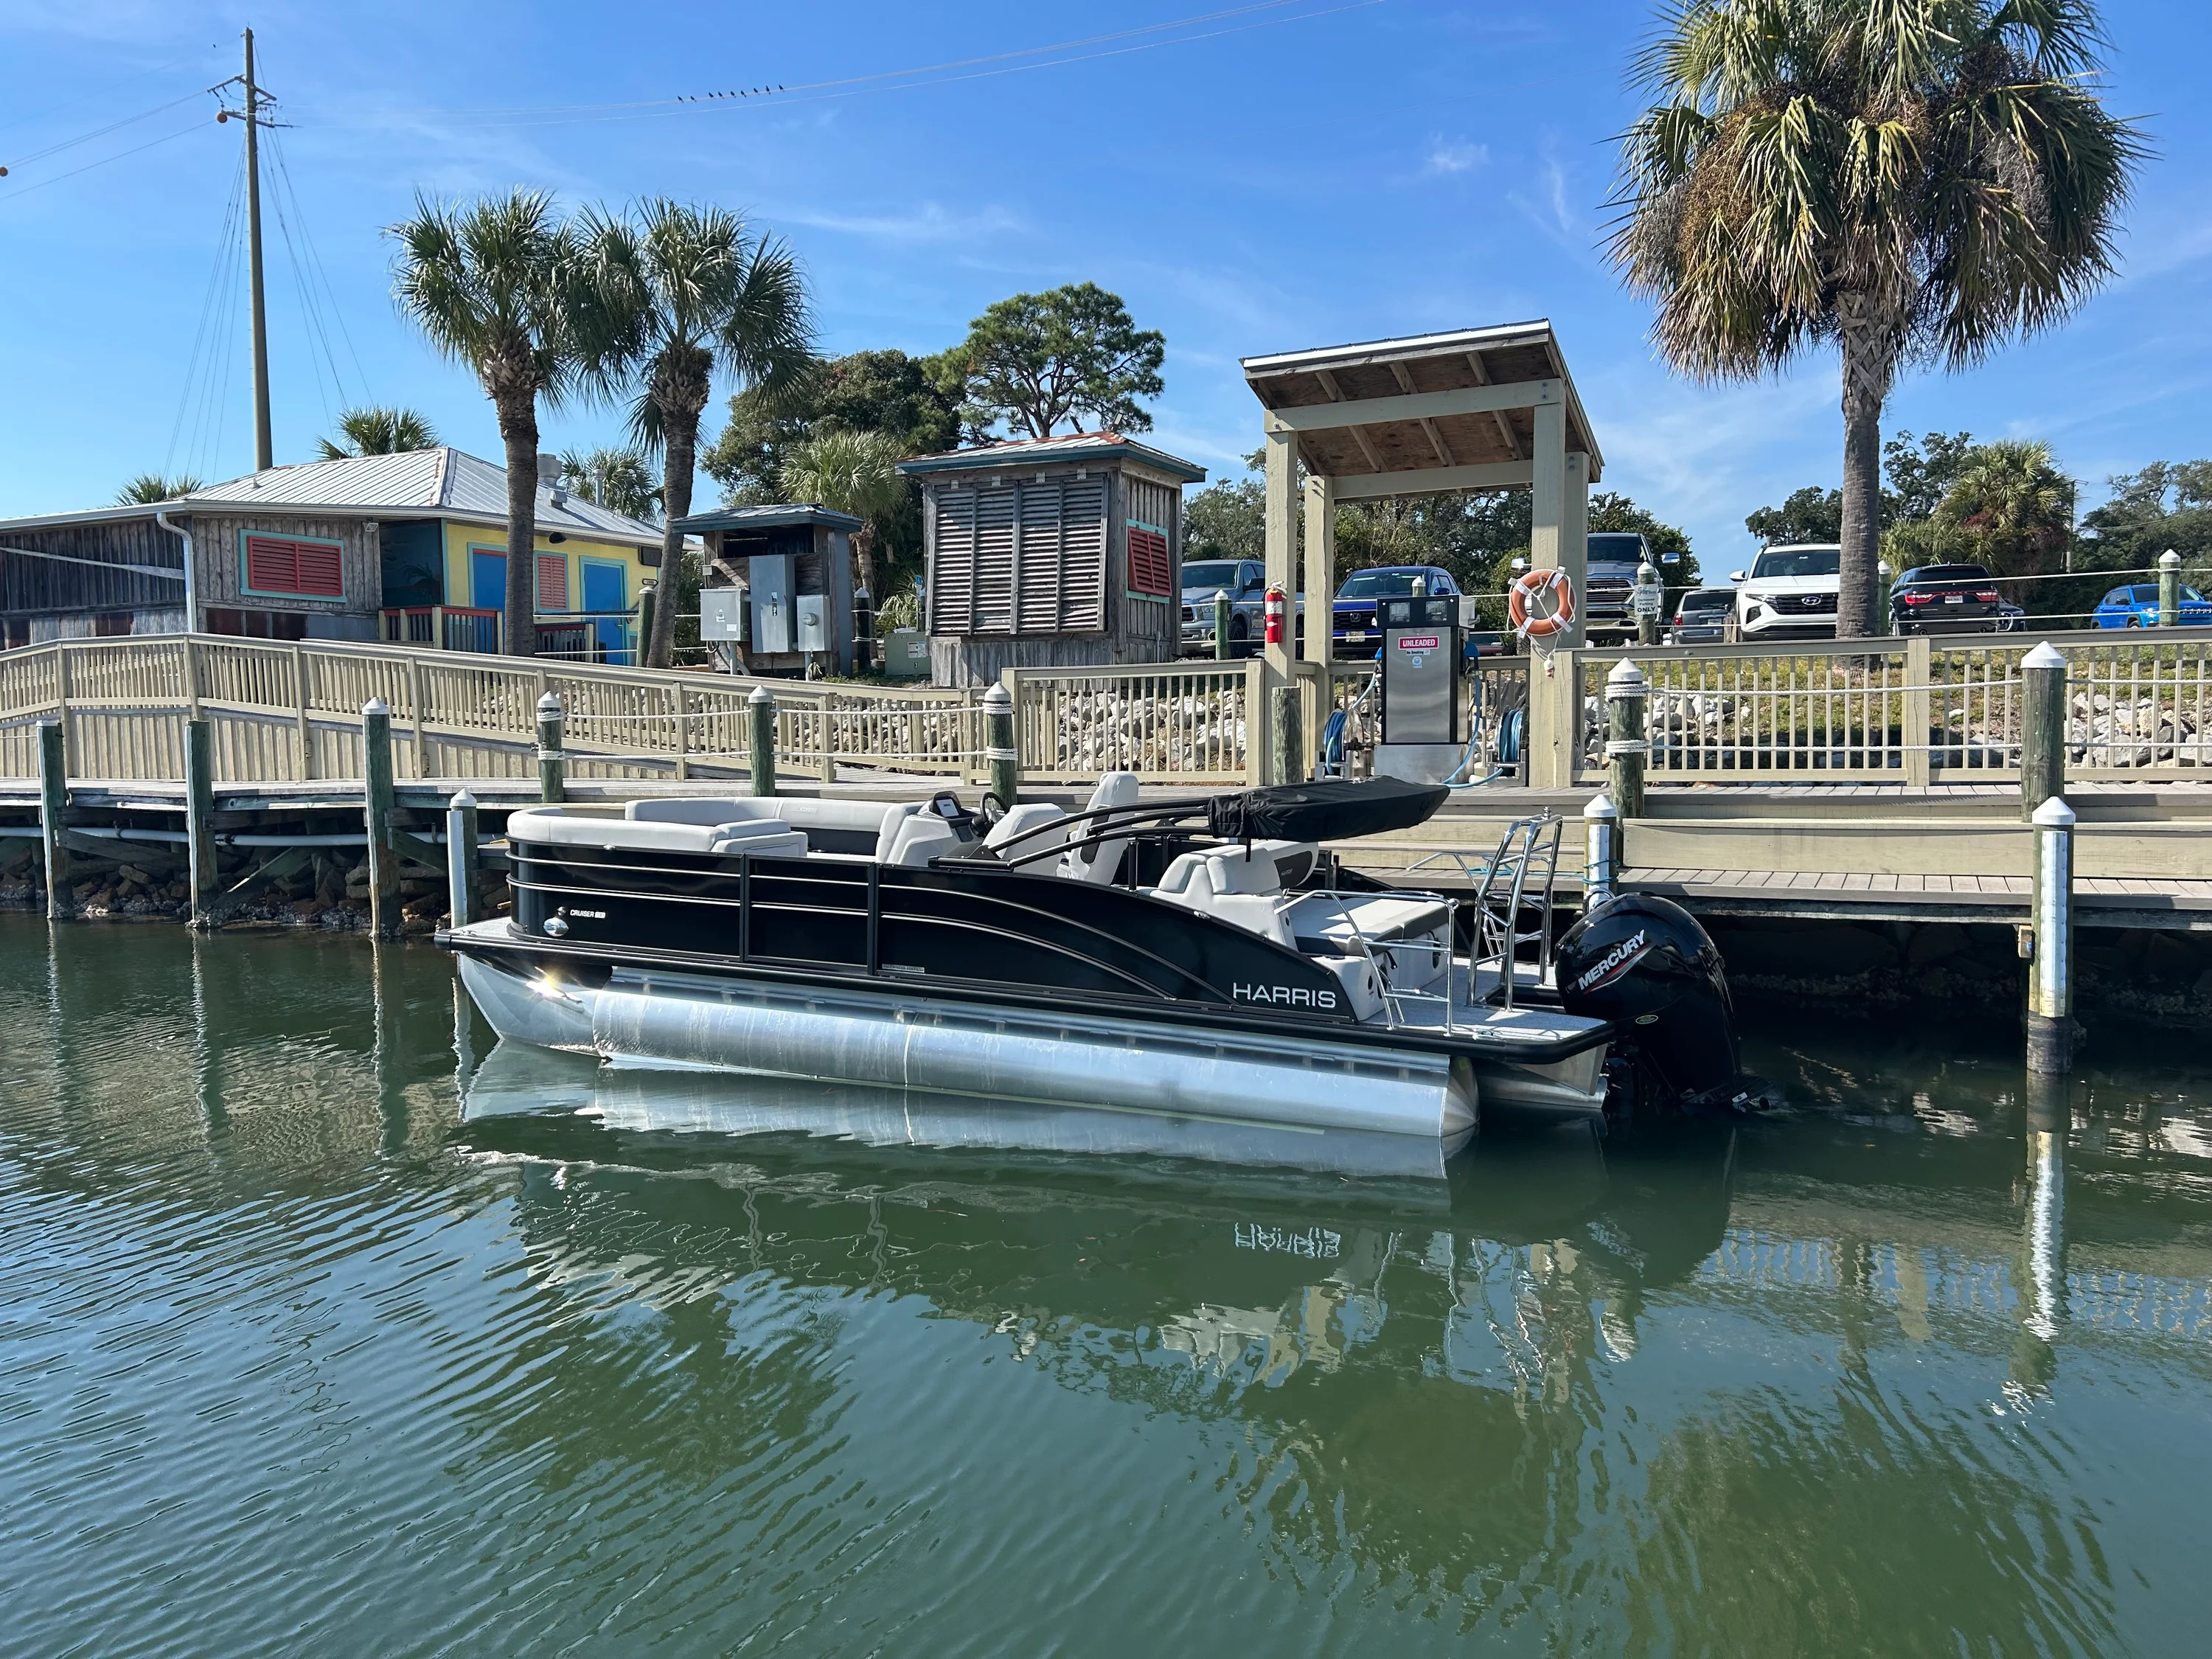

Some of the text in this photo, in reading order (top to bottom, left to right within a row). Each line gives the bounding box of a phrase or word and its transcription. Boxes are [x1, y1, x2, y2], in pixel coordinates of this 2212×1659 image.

[1402, 639, 1436, 647] UNLEADED
[570, 909, 594, 917] CRUISER
[1578, 929, 1644, 990] MERCURY
[1233, 982, 1336, 1008] HARRIS
